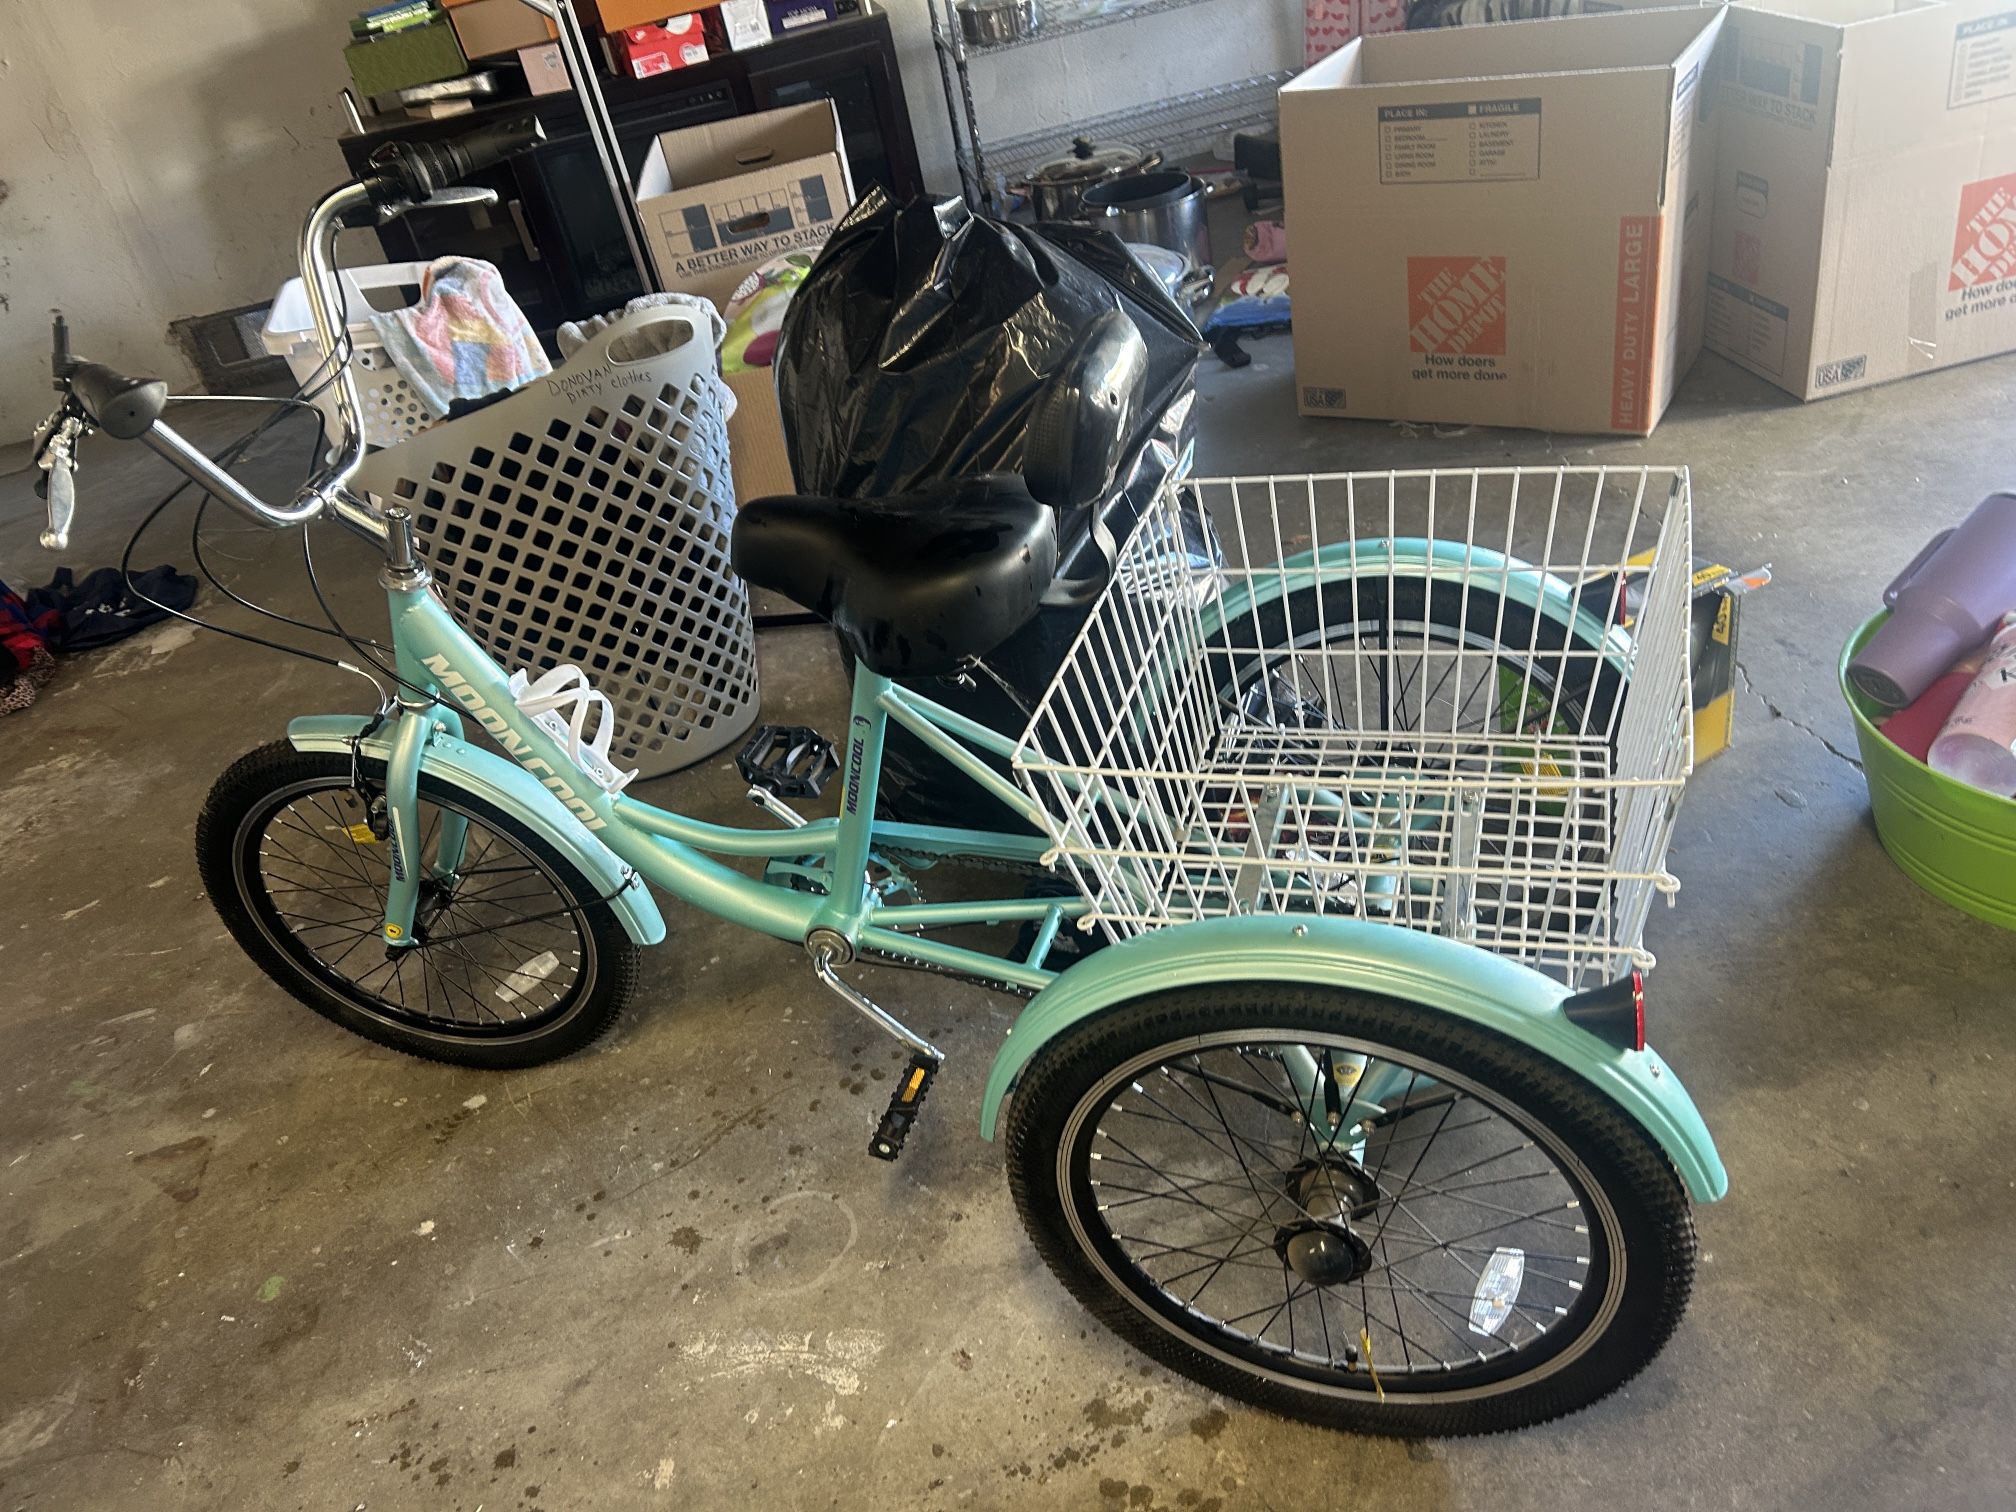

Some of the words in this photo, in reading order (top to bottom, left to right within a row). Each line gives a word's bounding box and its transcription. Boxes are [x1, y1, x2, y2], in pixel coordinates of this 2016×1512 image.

[1384, 108, 1413, 119] PLACE
[1478, 102, 1521, 114] FRAGILE
[676, 261, 686, 273] A
[686, 248, 740, 270] BETTER
[740, 239, 768, 257] WAY
[772, 234, 791, 248] TO
[793, 221, 835, 244] STACK
[1622, 223, 1643, 303] LARGE
[1410, 256, 1505, 352] HOME
[1417, 266, 1457, 306] THE
[1961, 284, 1993, 301] How
[1446, 293, 1505, 354] DEPOT
[1944, 303, 1968, 321] get
[1970, 296, 2006, 314] more
[1622, 311, 1640, 361] DUTY
[1411, 367, 1433, 381] get
[1437, 370, 1471, 381] more
[1474, 369, 1507, 381] done
[1424, 354, 1455, 366] How
[1458, 354, 1497, 368] doers
[545, 363, 613, 397] DONOVAN
[566, 383, 603, 405] DIRTY
[1619, 366, 1635, 424] HEAVY
[846, 736, 865, 816] MOONCOOL
